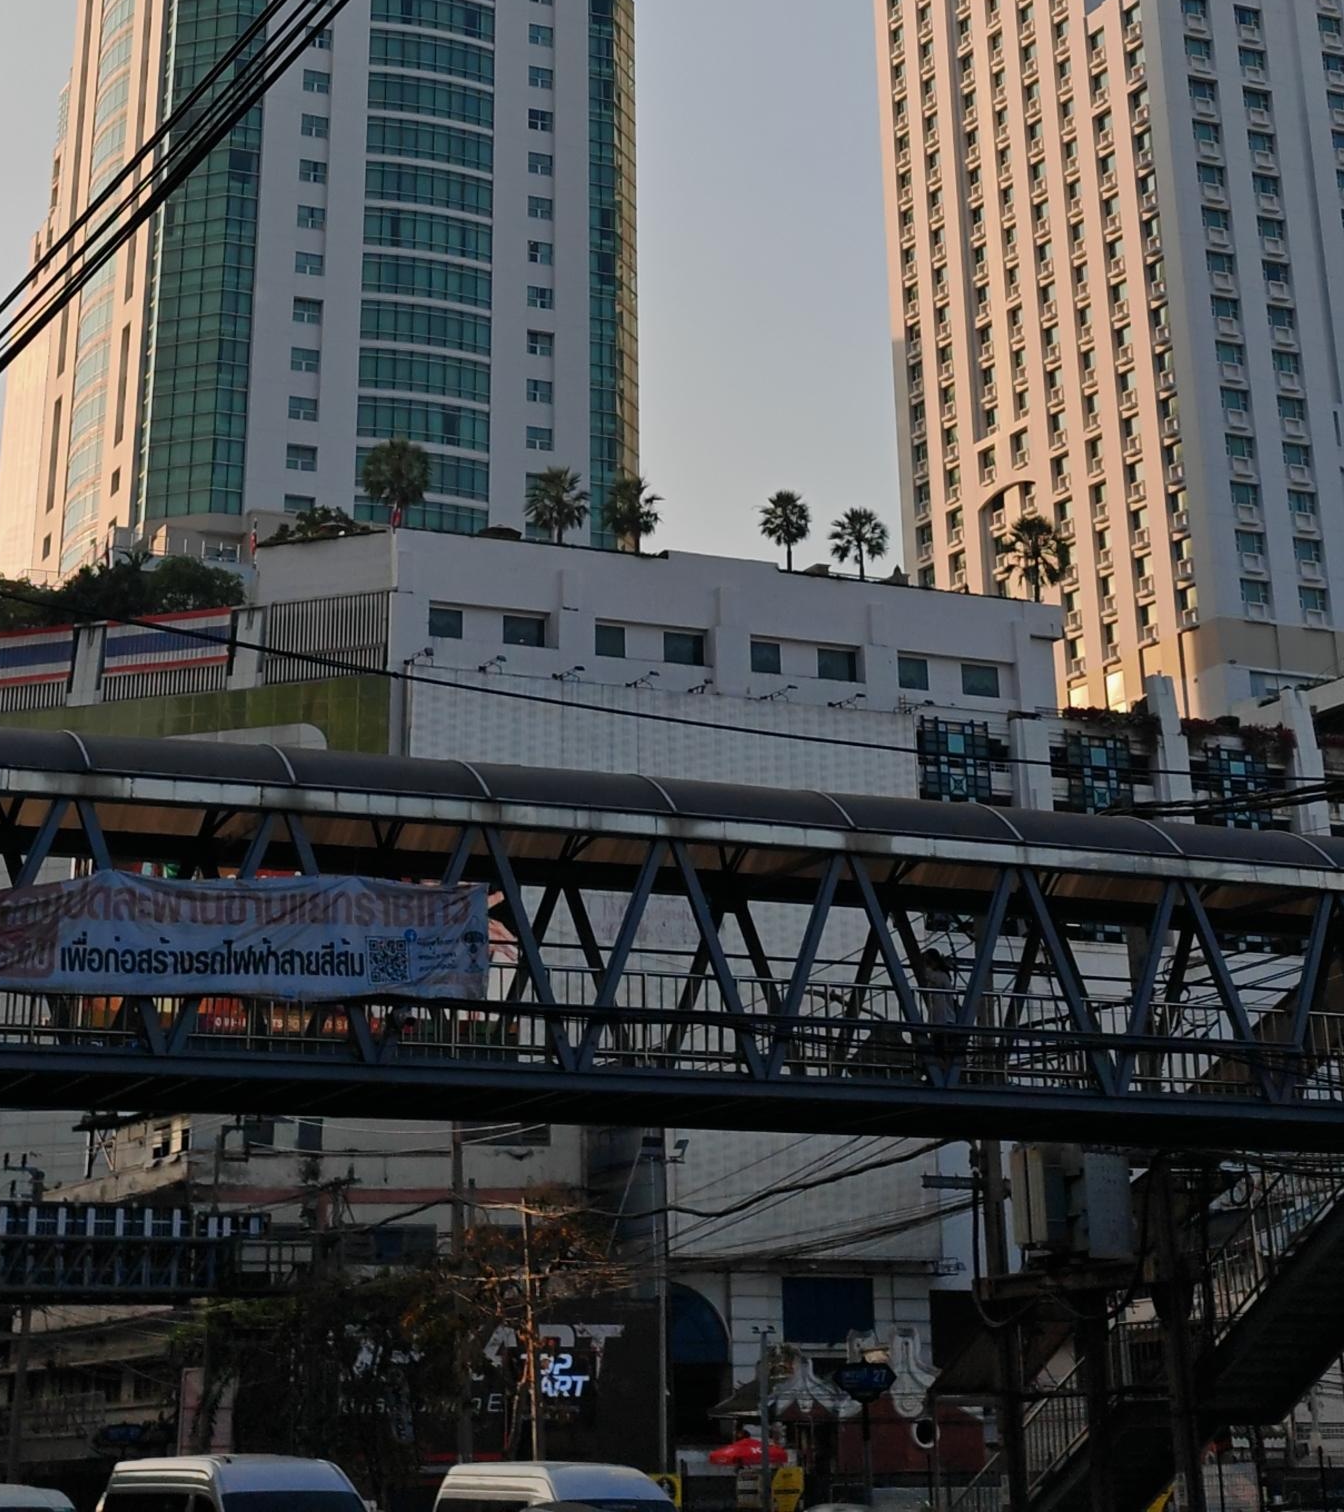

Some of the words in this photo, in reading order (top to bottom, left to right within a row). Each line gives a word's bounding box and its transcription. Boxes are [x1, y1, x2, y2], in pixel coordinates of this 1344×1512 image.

[60, 931, 365, 977] เพื่อก่อสร้างรถไฟฟ้าสายสีส้ม
